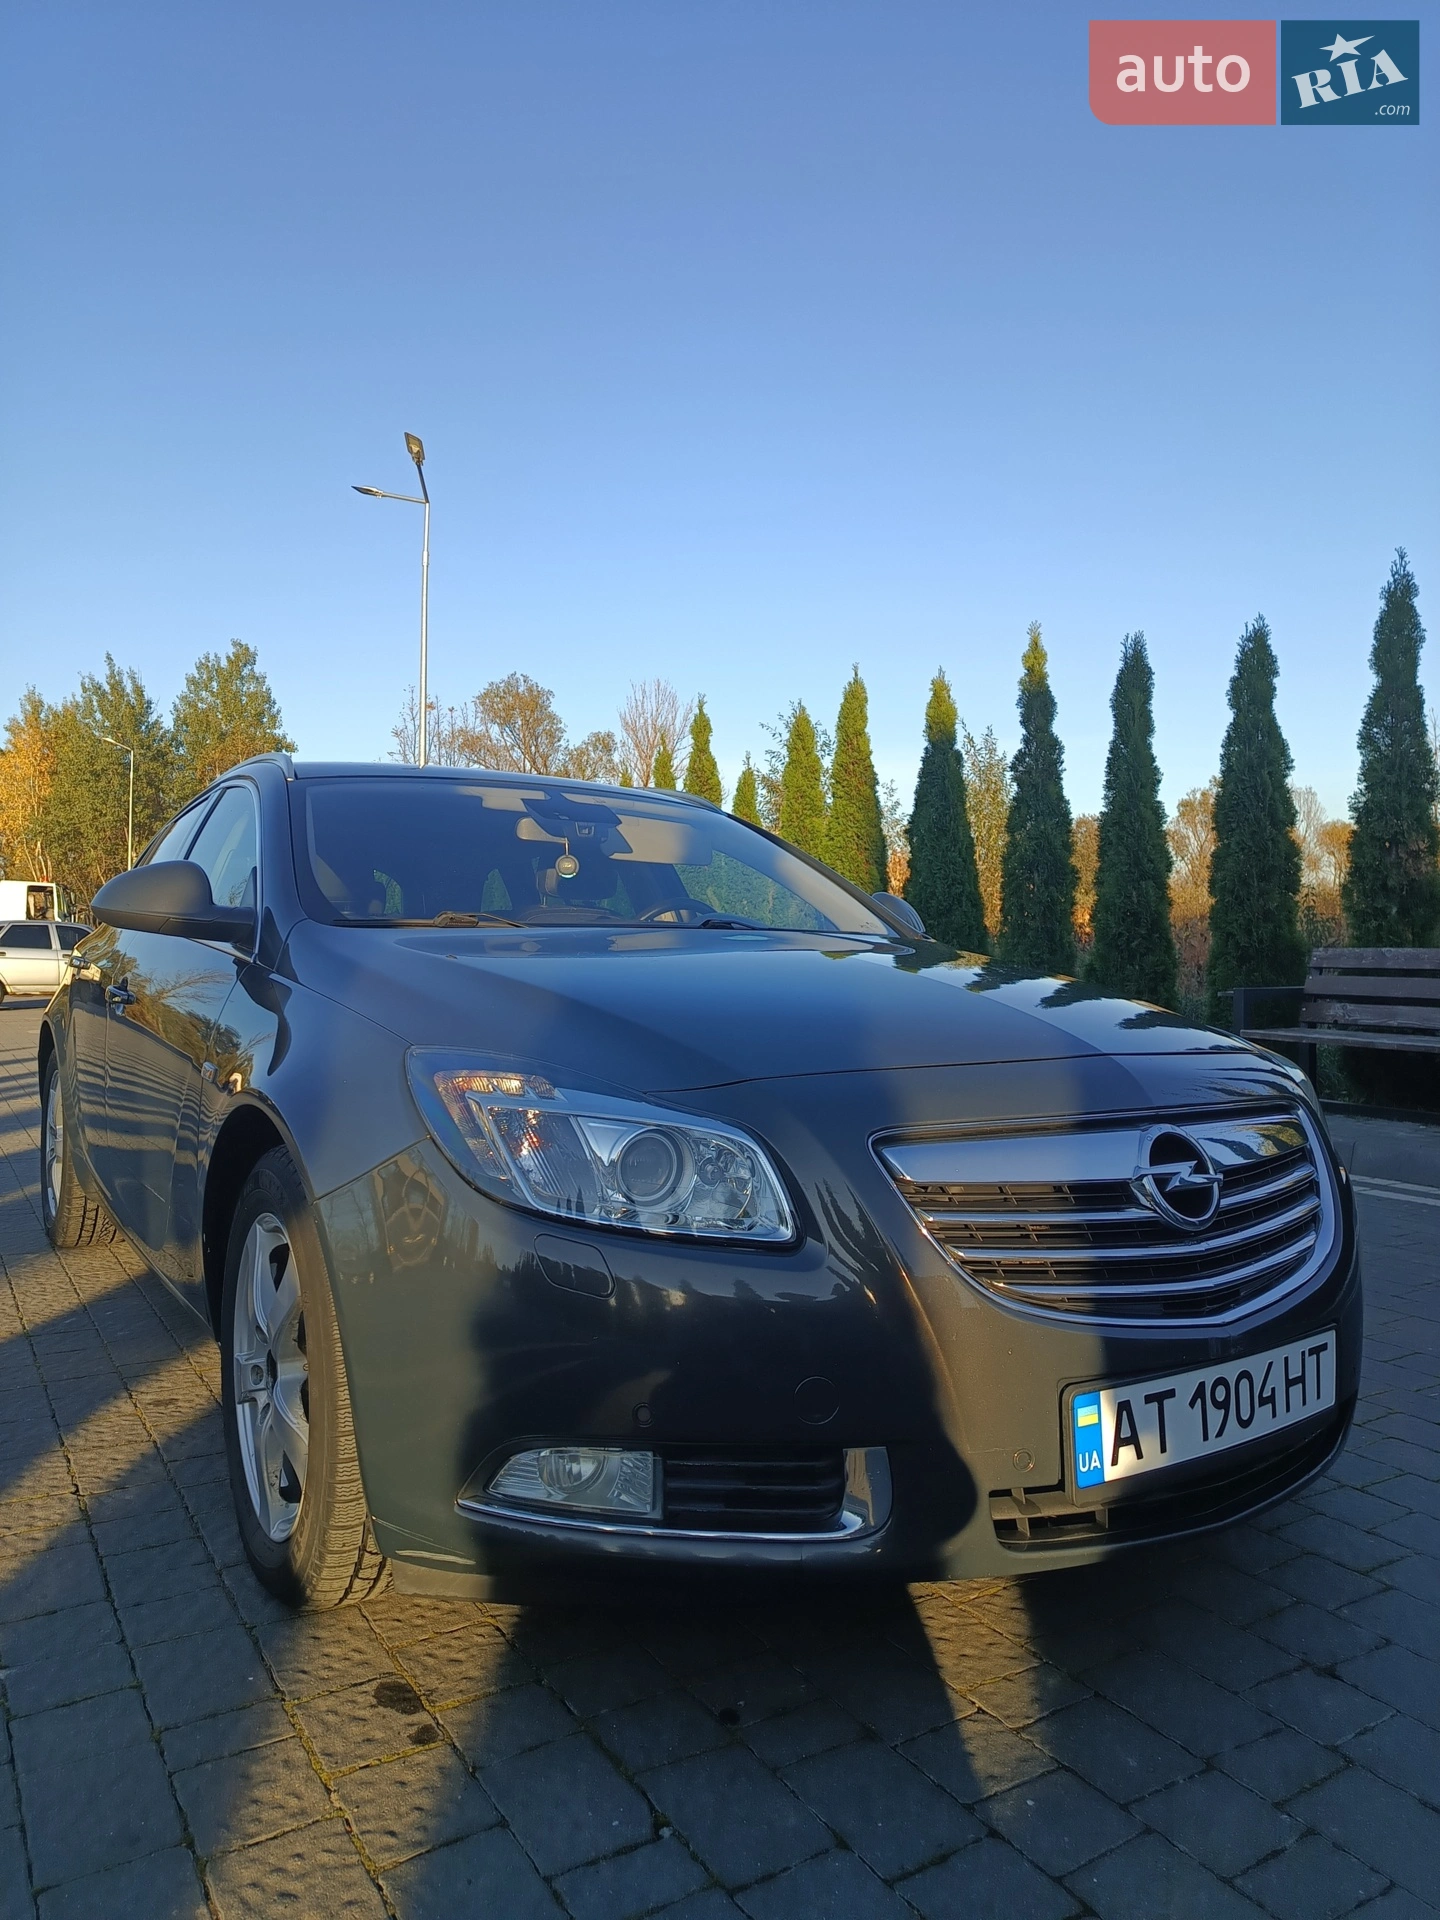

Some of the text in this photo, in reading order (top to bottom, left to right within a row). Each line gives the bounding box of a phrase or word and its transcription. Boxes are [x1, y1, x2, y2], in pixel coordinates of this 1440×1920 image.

[1111, 1342, 1328, 1467] AT 1904 HT
[1078, 1450, 1102, 1473] UA
